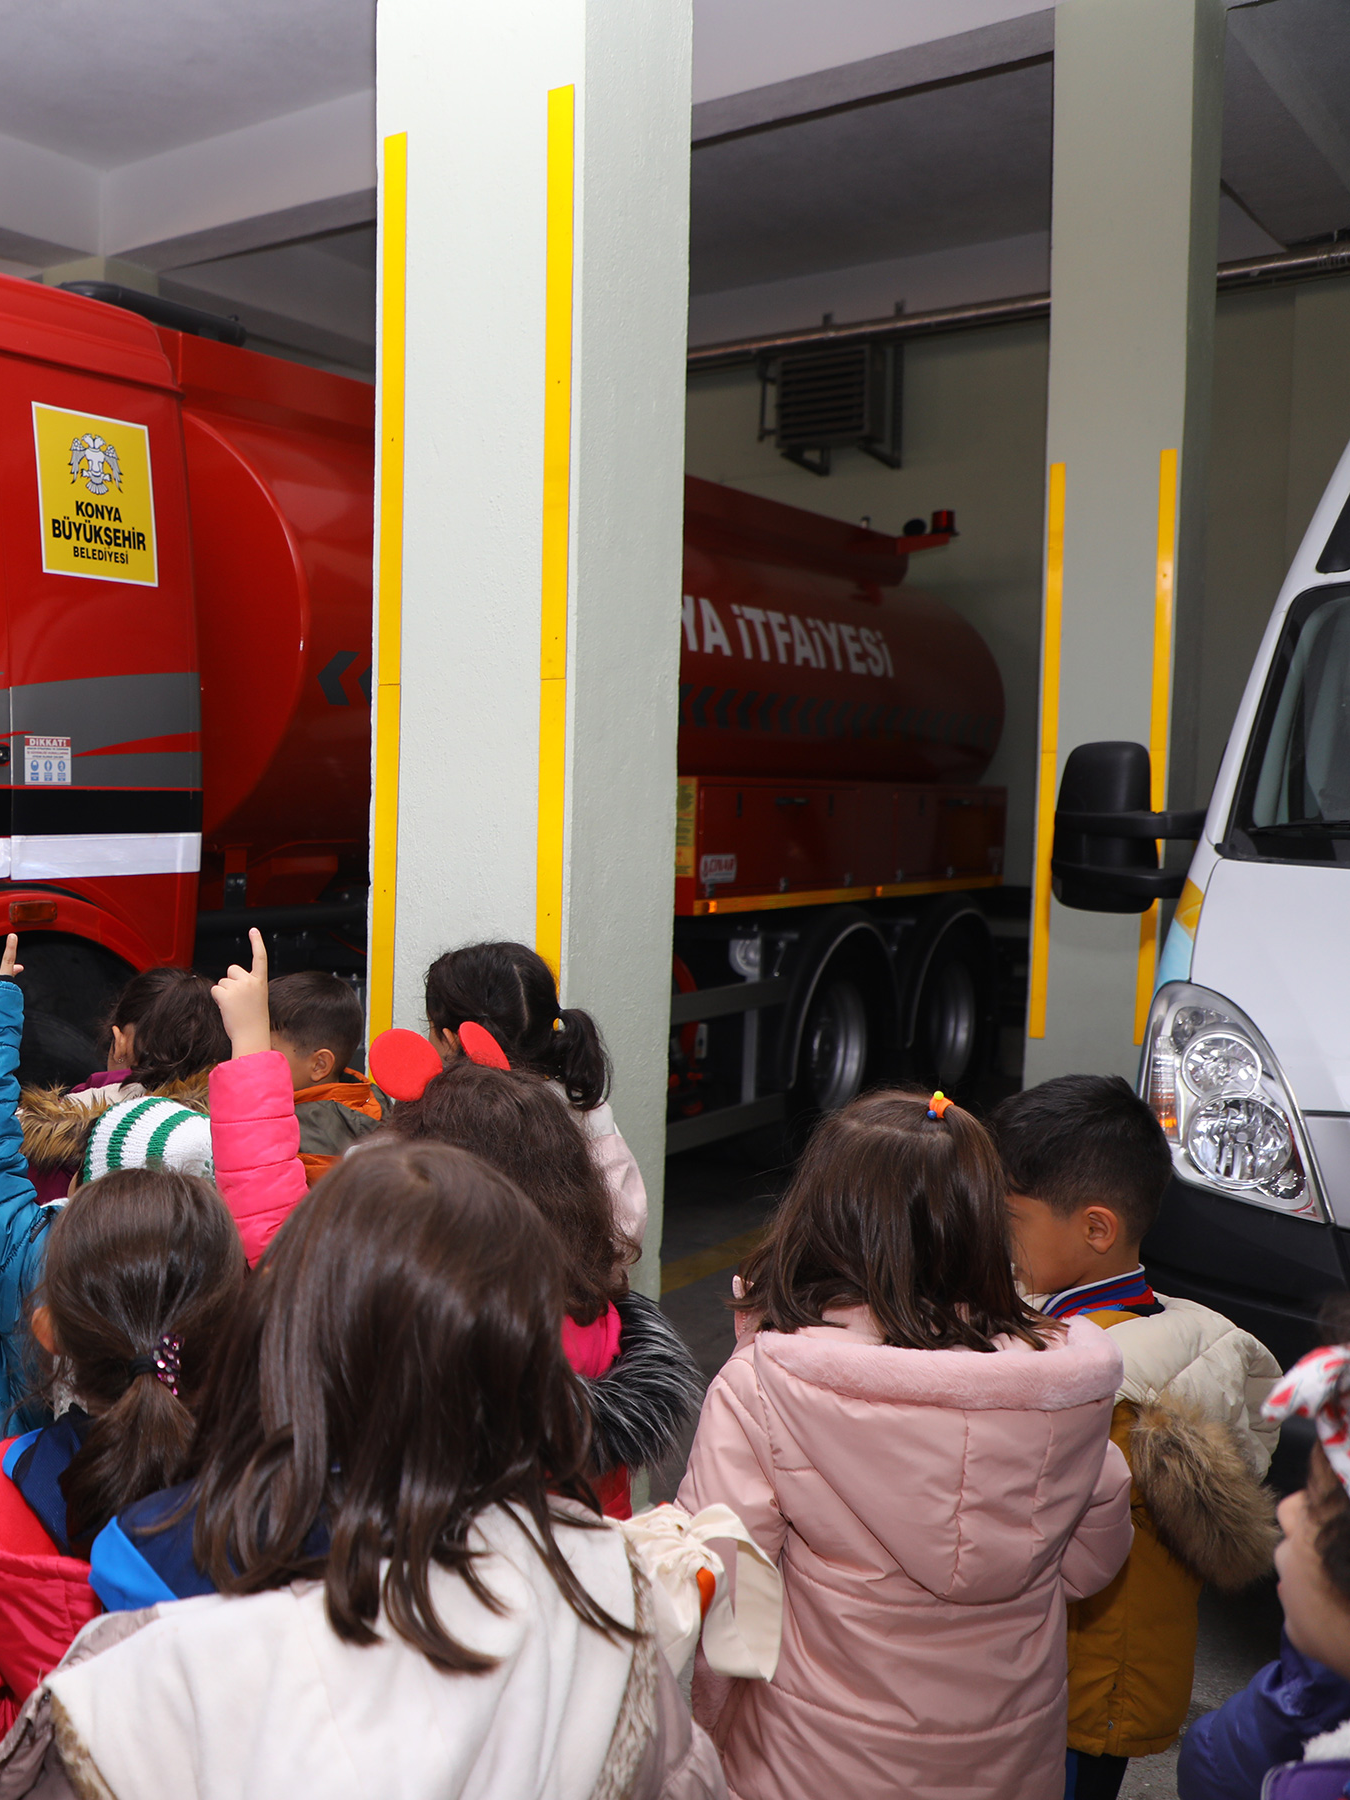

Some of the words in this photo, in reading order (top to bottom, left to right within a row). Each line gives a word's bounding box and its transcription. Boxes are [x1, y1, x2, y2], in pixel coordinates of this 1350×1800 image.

[76, 500, 122, 523] KONYA
[52, 516, 146, 551] BÜYÜKŞEHİR
[73, 546, 129, 564] BELEDİYESİ
